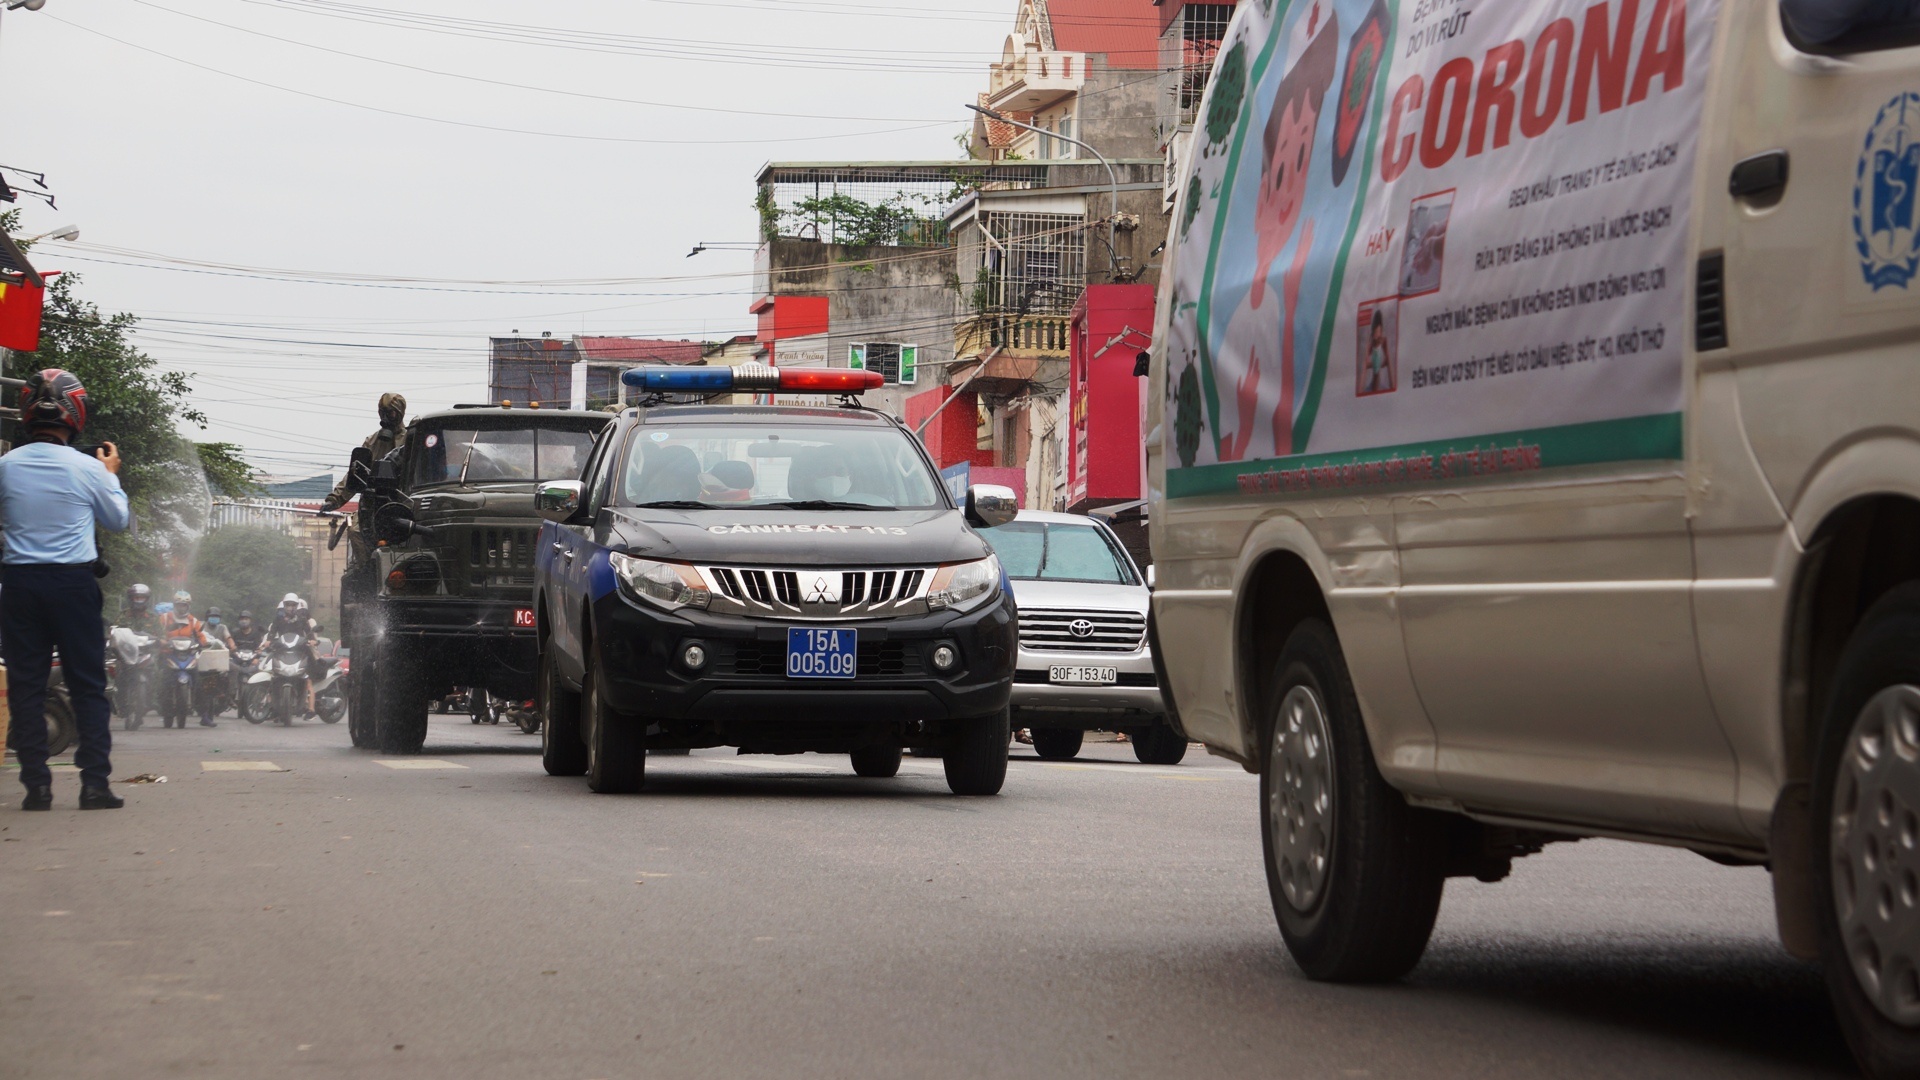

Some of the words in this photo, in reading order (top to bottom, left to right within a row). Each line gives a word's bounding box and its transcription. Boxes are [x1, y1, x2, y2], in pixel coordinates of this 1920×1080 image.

[1406, 30, 1423, 58] DO
[1425, 23, 1438, 48] VI
[1437, 8, 1471, 43] RÚT
[1381, 0, 1687, 183] CORONA
[1559, 168, 1593, 196] TRANG
[1601, 157, 1616, 184] TẾ
[1616, 151, 1646, 179] ĐÚNG
[1648, 142, 1679, 170] CÁCH
[1497, 244, 1513, 267] TAY
[1557, 225, 1590, 252] PHÒNG
[1593, 216, 1606, 243] VÀ
[1607, 209, 1639, 241] NƯỚC
[1641, 205, 1672, 238] SẠCH
[1475, 301, 1499, 329] BỆNH
[1521, 288, 1554, 315] KHÔNG
[1429, 364, 1450, 386] NGAY
[1516, 346, 1530, 372] CÓ
[709, 523, 791, 535] CẢNH
[794, 523, 851, 534] SÁT
[861, 526, 907, 536] 113
[807, 630, 840, 651] 15A
[789, 652, 854, 674] 005.09
[1051, 667, 1115, 681] 30F-153.40
